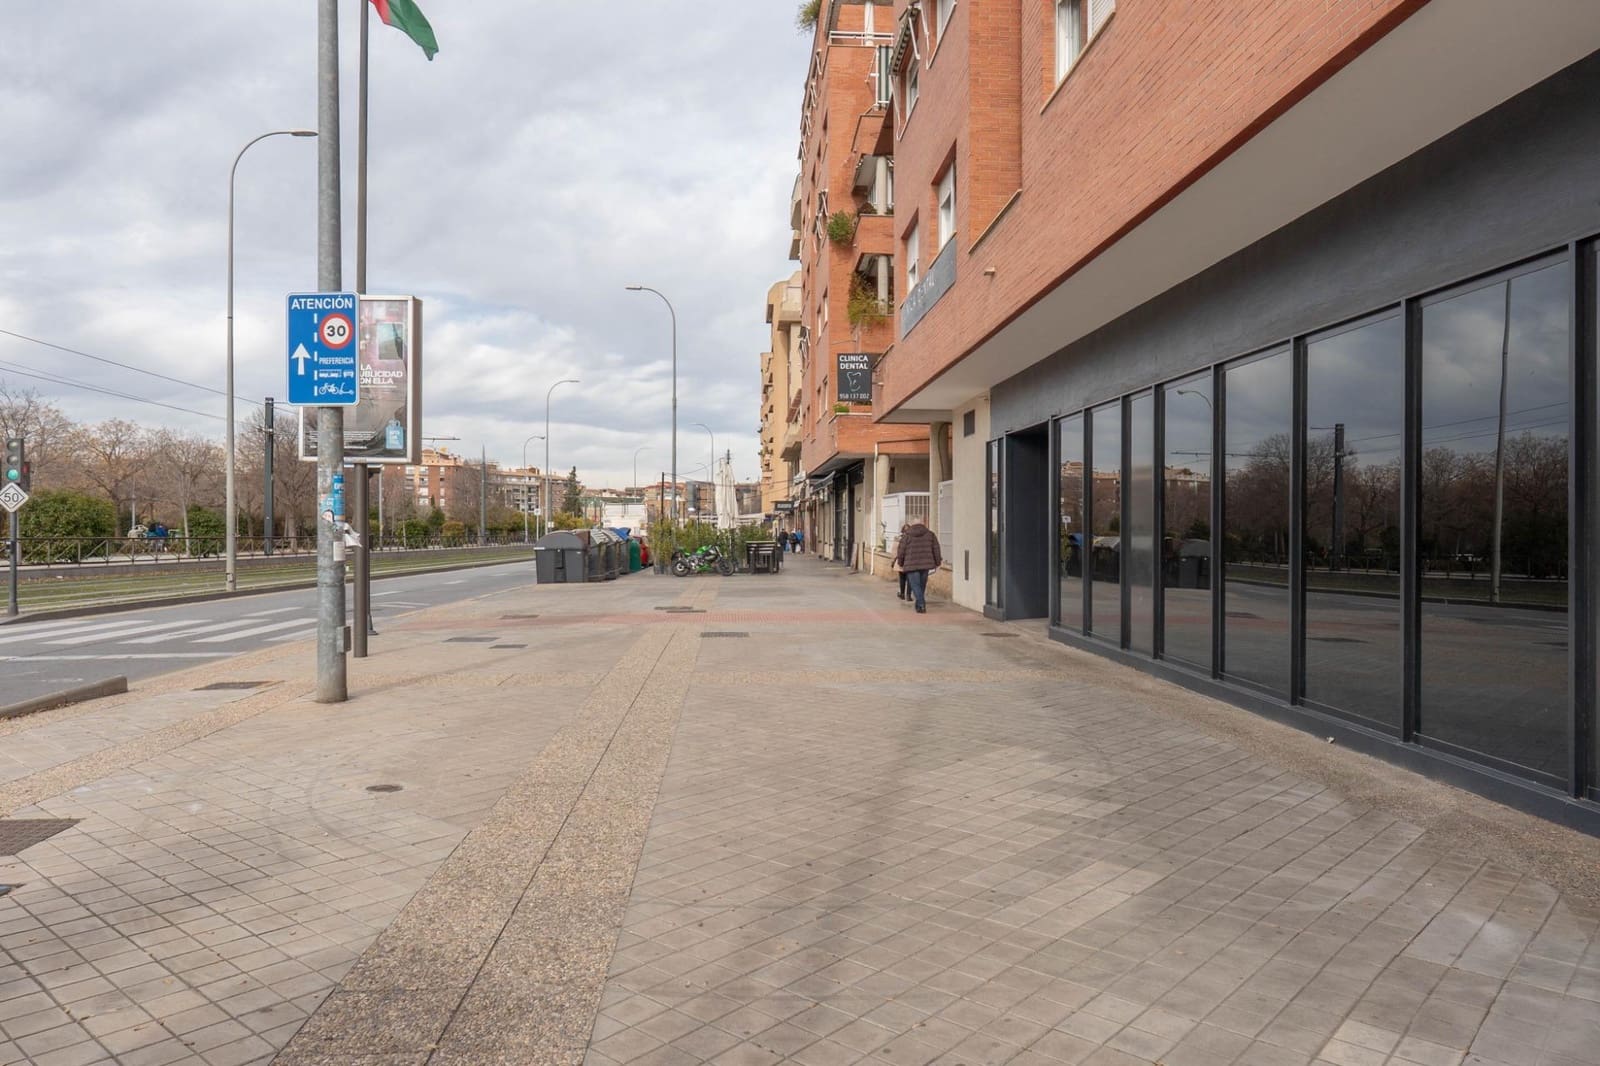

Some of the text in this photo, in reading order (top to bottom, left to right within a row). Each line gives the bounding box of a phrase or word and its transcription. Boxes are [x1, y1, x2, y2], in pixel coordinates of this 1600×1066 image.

[291, 295, 353, 310] ATENCIÓN
[326, 325, 346, 337] 30
[318, 357, 354, 365] PREFERENCIA
[359, 370, 403, 378] UBLICIDAD
[359, 377, 394, 385] ON ELLA
[4, 492, 19, 503] 50
